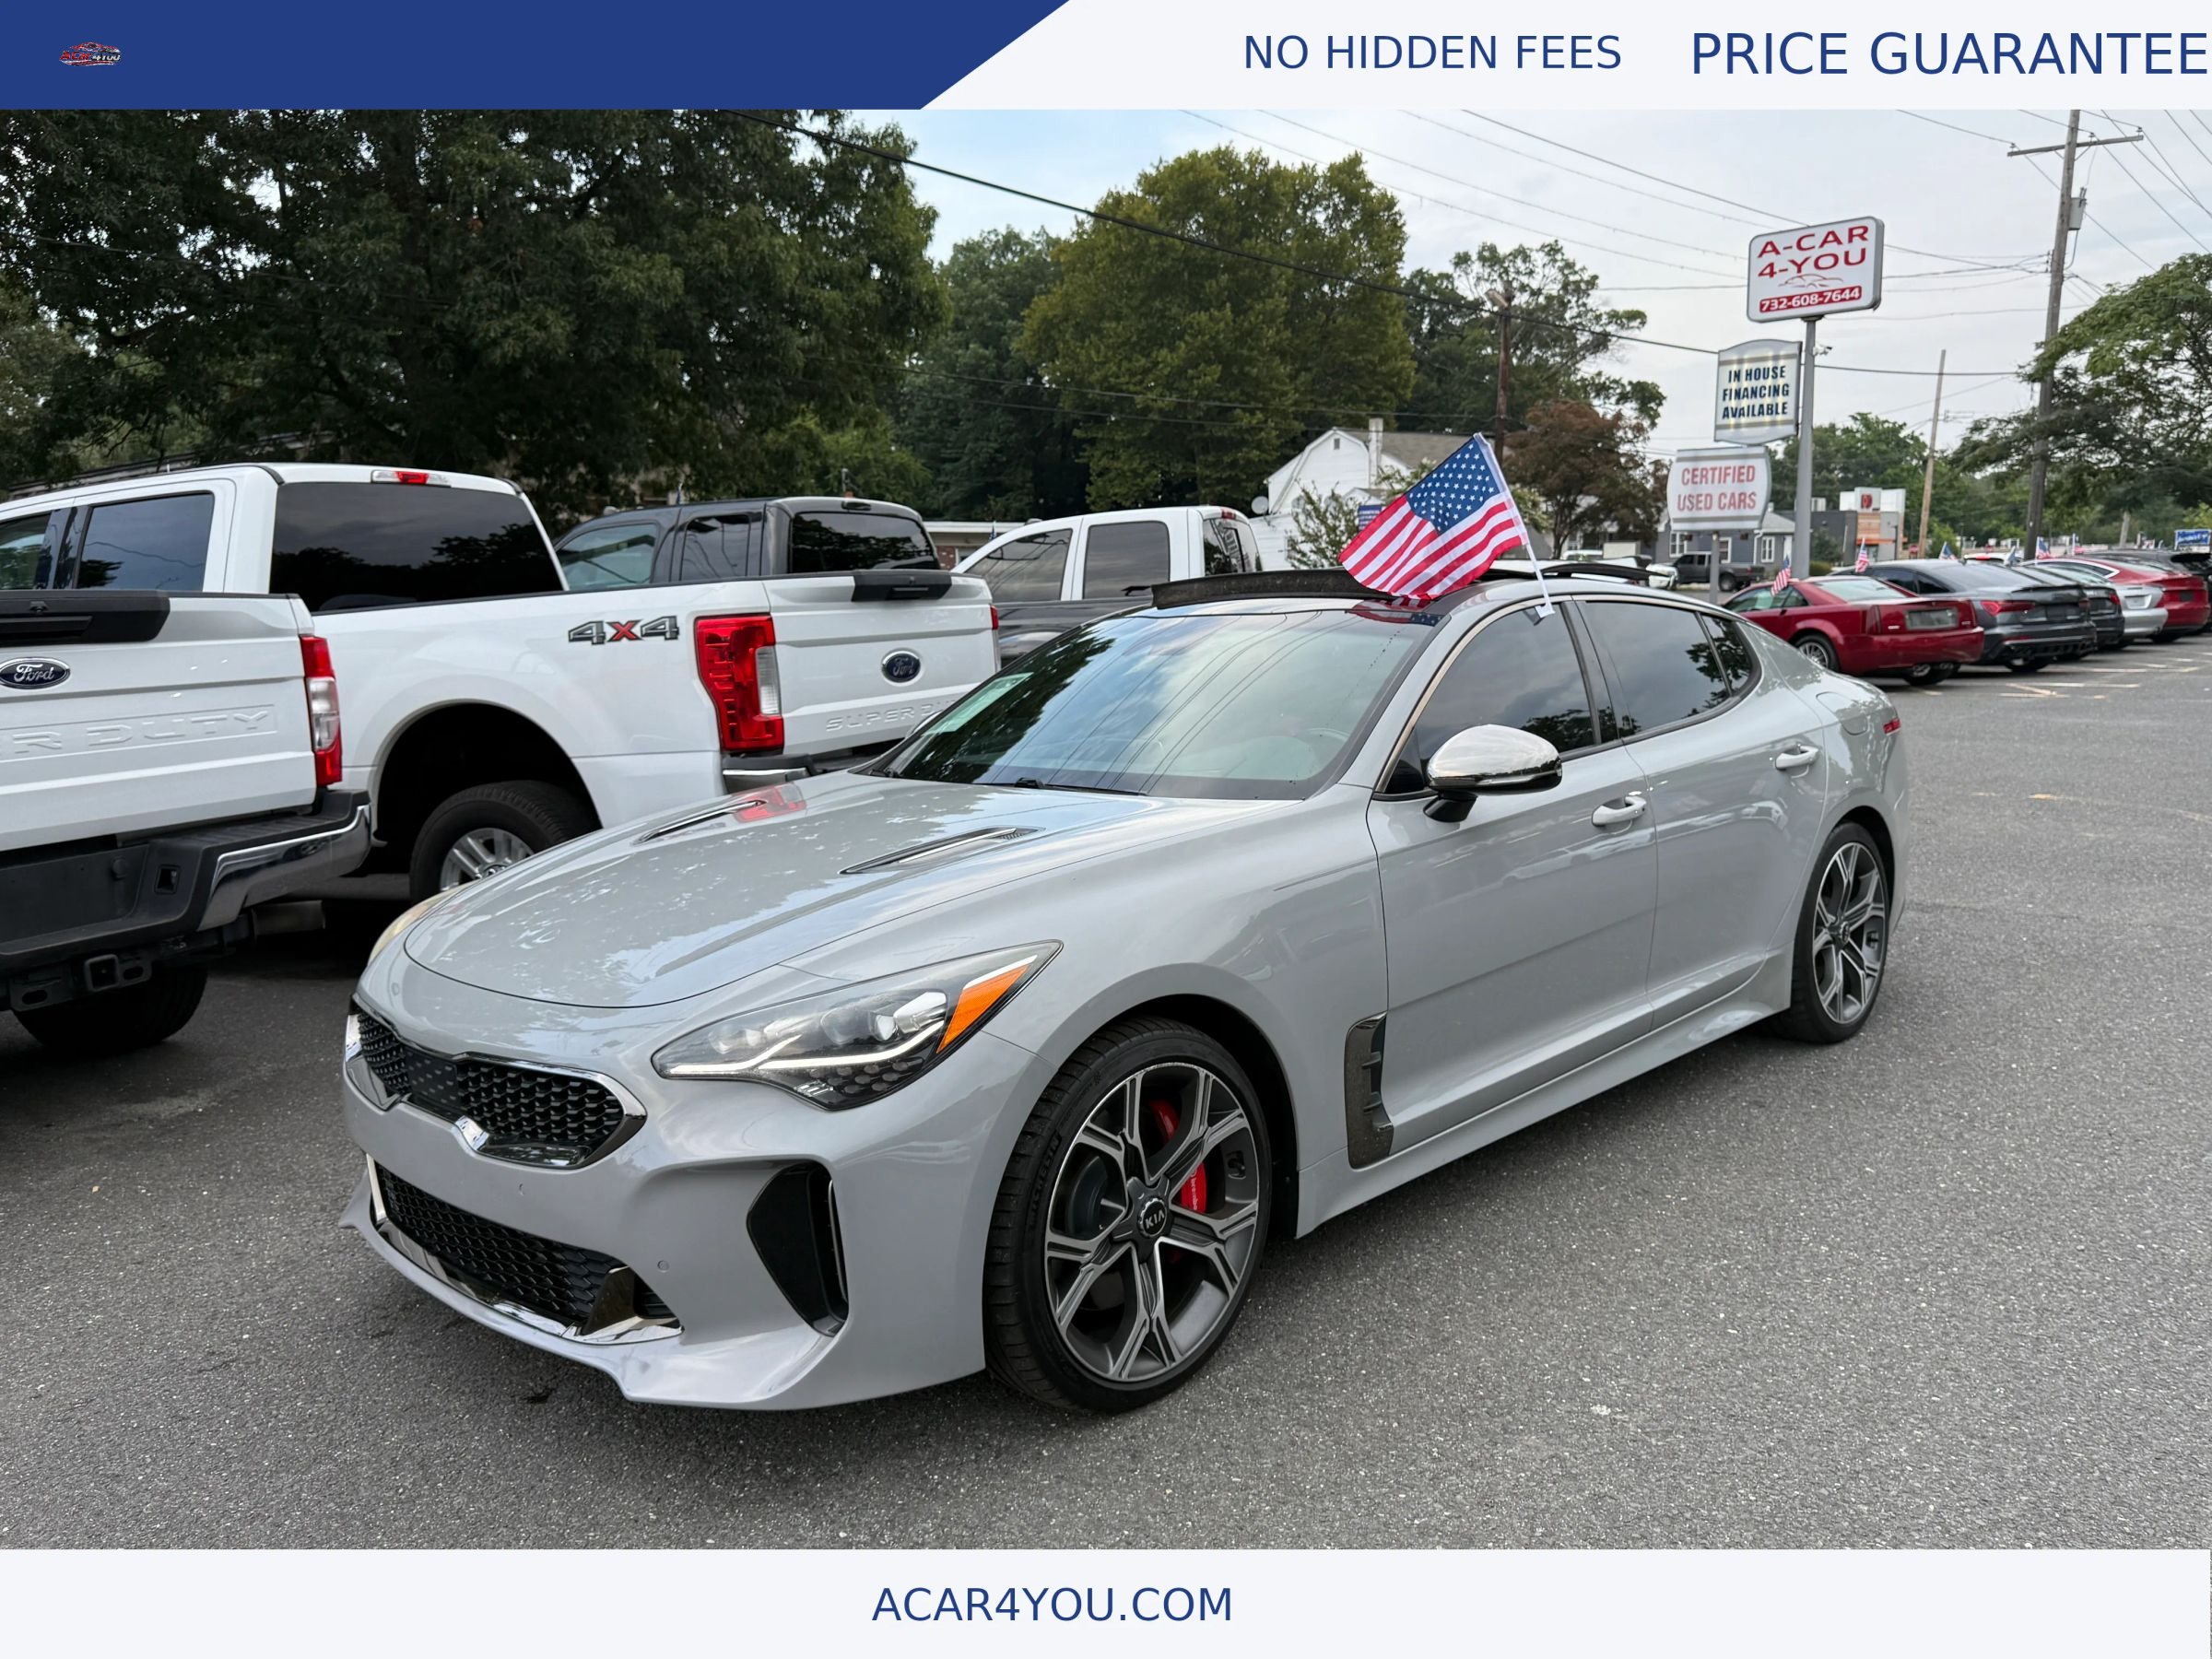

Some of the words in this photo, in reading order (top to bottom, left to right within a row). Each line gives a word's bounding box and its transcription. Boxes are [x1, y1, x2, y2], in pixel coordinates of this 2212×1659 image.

[1757, 225, 1869, 258] A-CAR
[1757, 247, 1867, 278] 4-YOU
[1761, 287, 1860, 312] 732-608-7644
[1728, 369, 1741, 383] IN
[1744, 365, 1786, 381] HOUSE
[1722, 383, 1790, 402] FINANCING
[1722, 402, 1788, 419] AVAILABLE
[1681, 465, 1756, 486] CERTIFIED
[1677, 492, 1713, 512] USED
[1717, 491, 1757, 511] CARS
[13, 664, 55, 683] Ford
[87, 711, 268, 747] DUTY
[825, 706, 915, 732] SUPER
[1145, 1209, 1165, 1230] KIA
